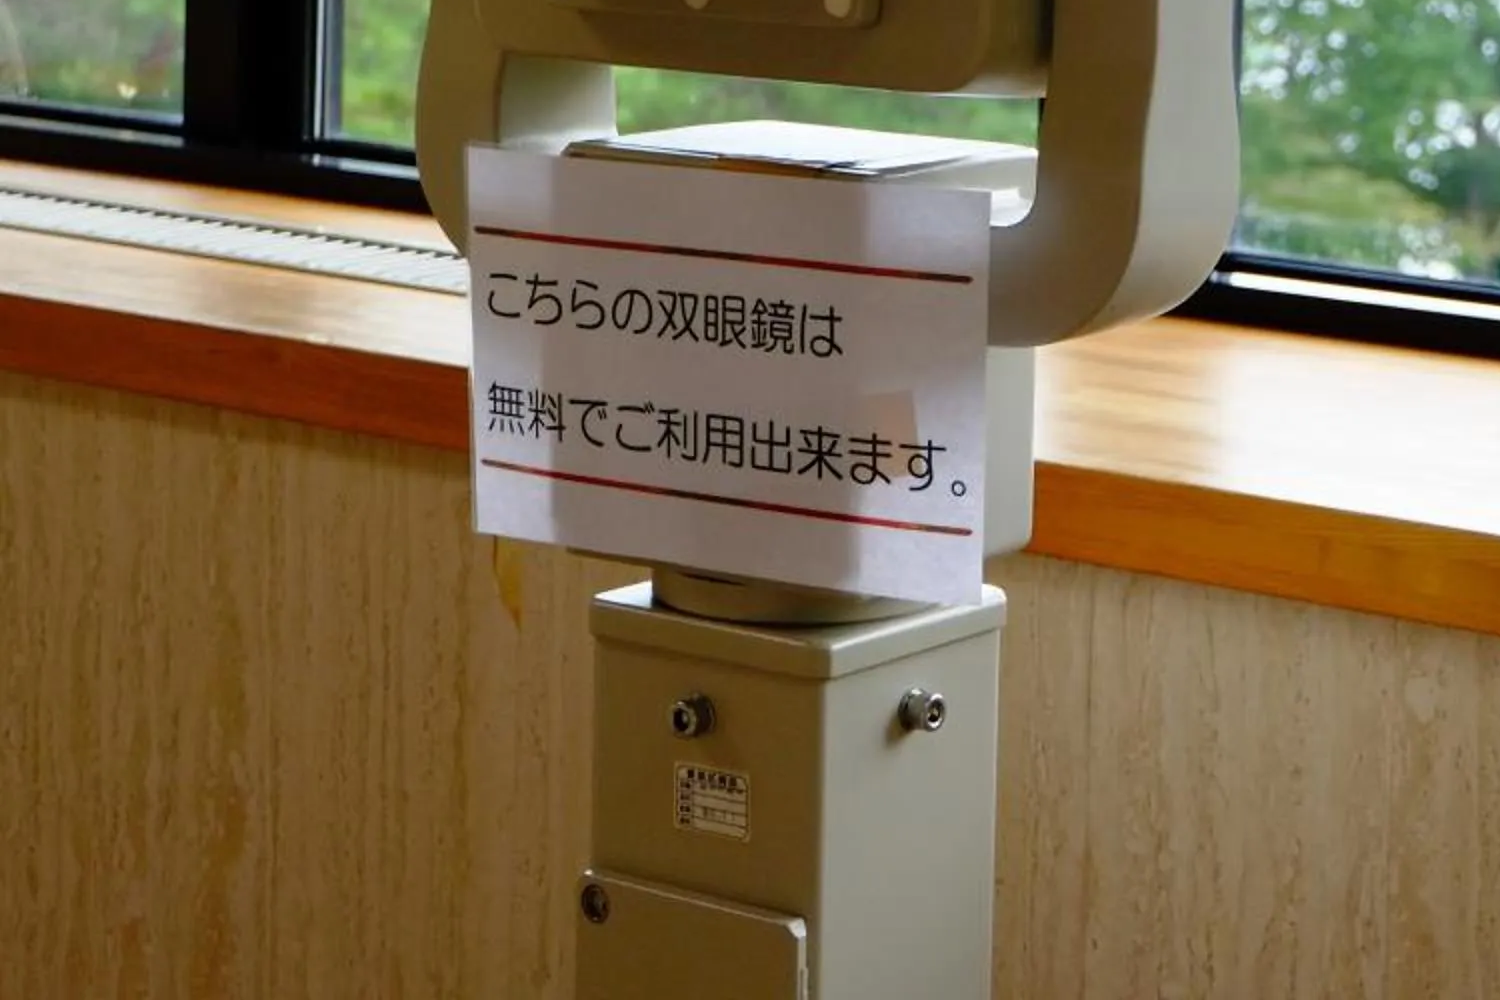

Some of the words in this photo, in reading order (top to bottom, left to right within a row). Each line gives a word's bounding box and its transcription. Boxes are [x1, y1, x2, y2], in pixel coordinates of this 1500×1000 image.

[487, 272, 844, 358] こちらの双眼鏡は
[487, 381, 968, 498] 無料でご利用出来ます。
